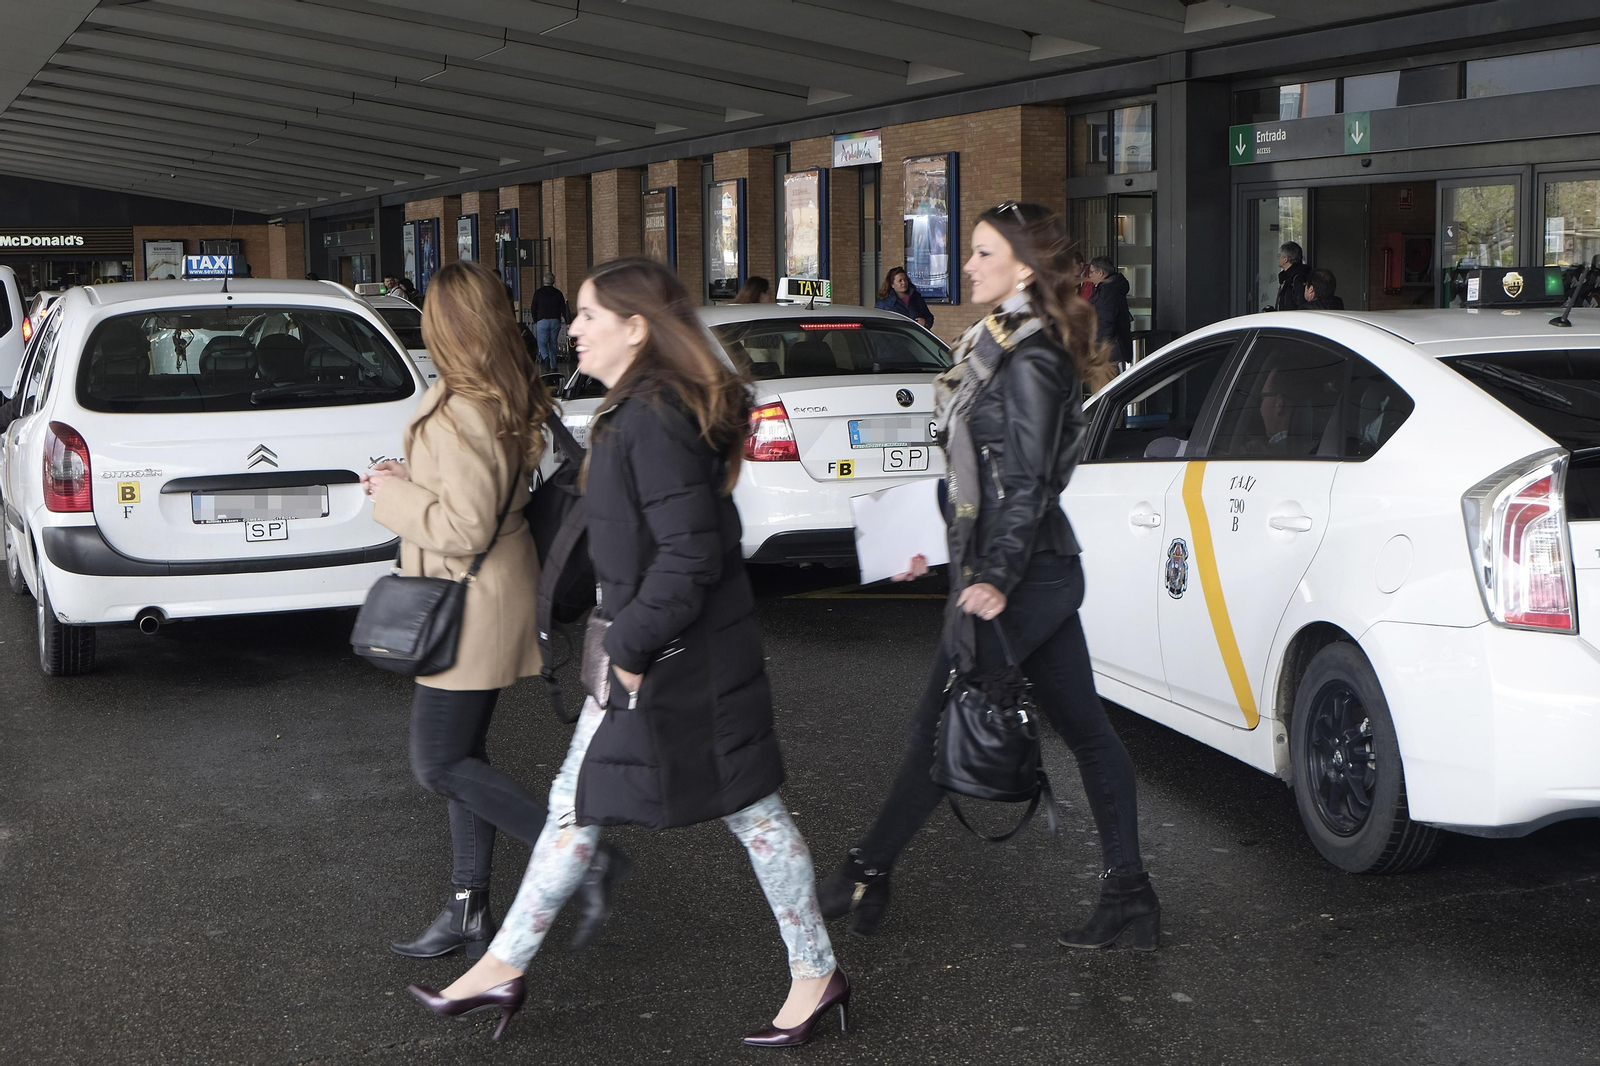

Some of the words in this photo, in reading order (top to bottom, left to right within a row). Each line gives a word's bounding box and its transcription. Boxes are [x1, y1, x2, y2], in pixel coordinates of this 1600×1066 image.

[1256, 129, 1287, 143] Entrada
[1256, 147, 1271, 155] ACCESS
[0, 235, 84, 247] McDonald's
[187, 255, 233, 270] TAXI
[797, 280, 823, 296] TAXI
[828, 462, 837, 474] F
[839, 462, 852, 476] B
[1230, 475, 1257, 492] TAXI
[121, 486, 136, 501] B
[124, 505, 134, 519] F
[1230, 498, 1245, 514] 790
[1232, 516, 1239, 532] B
